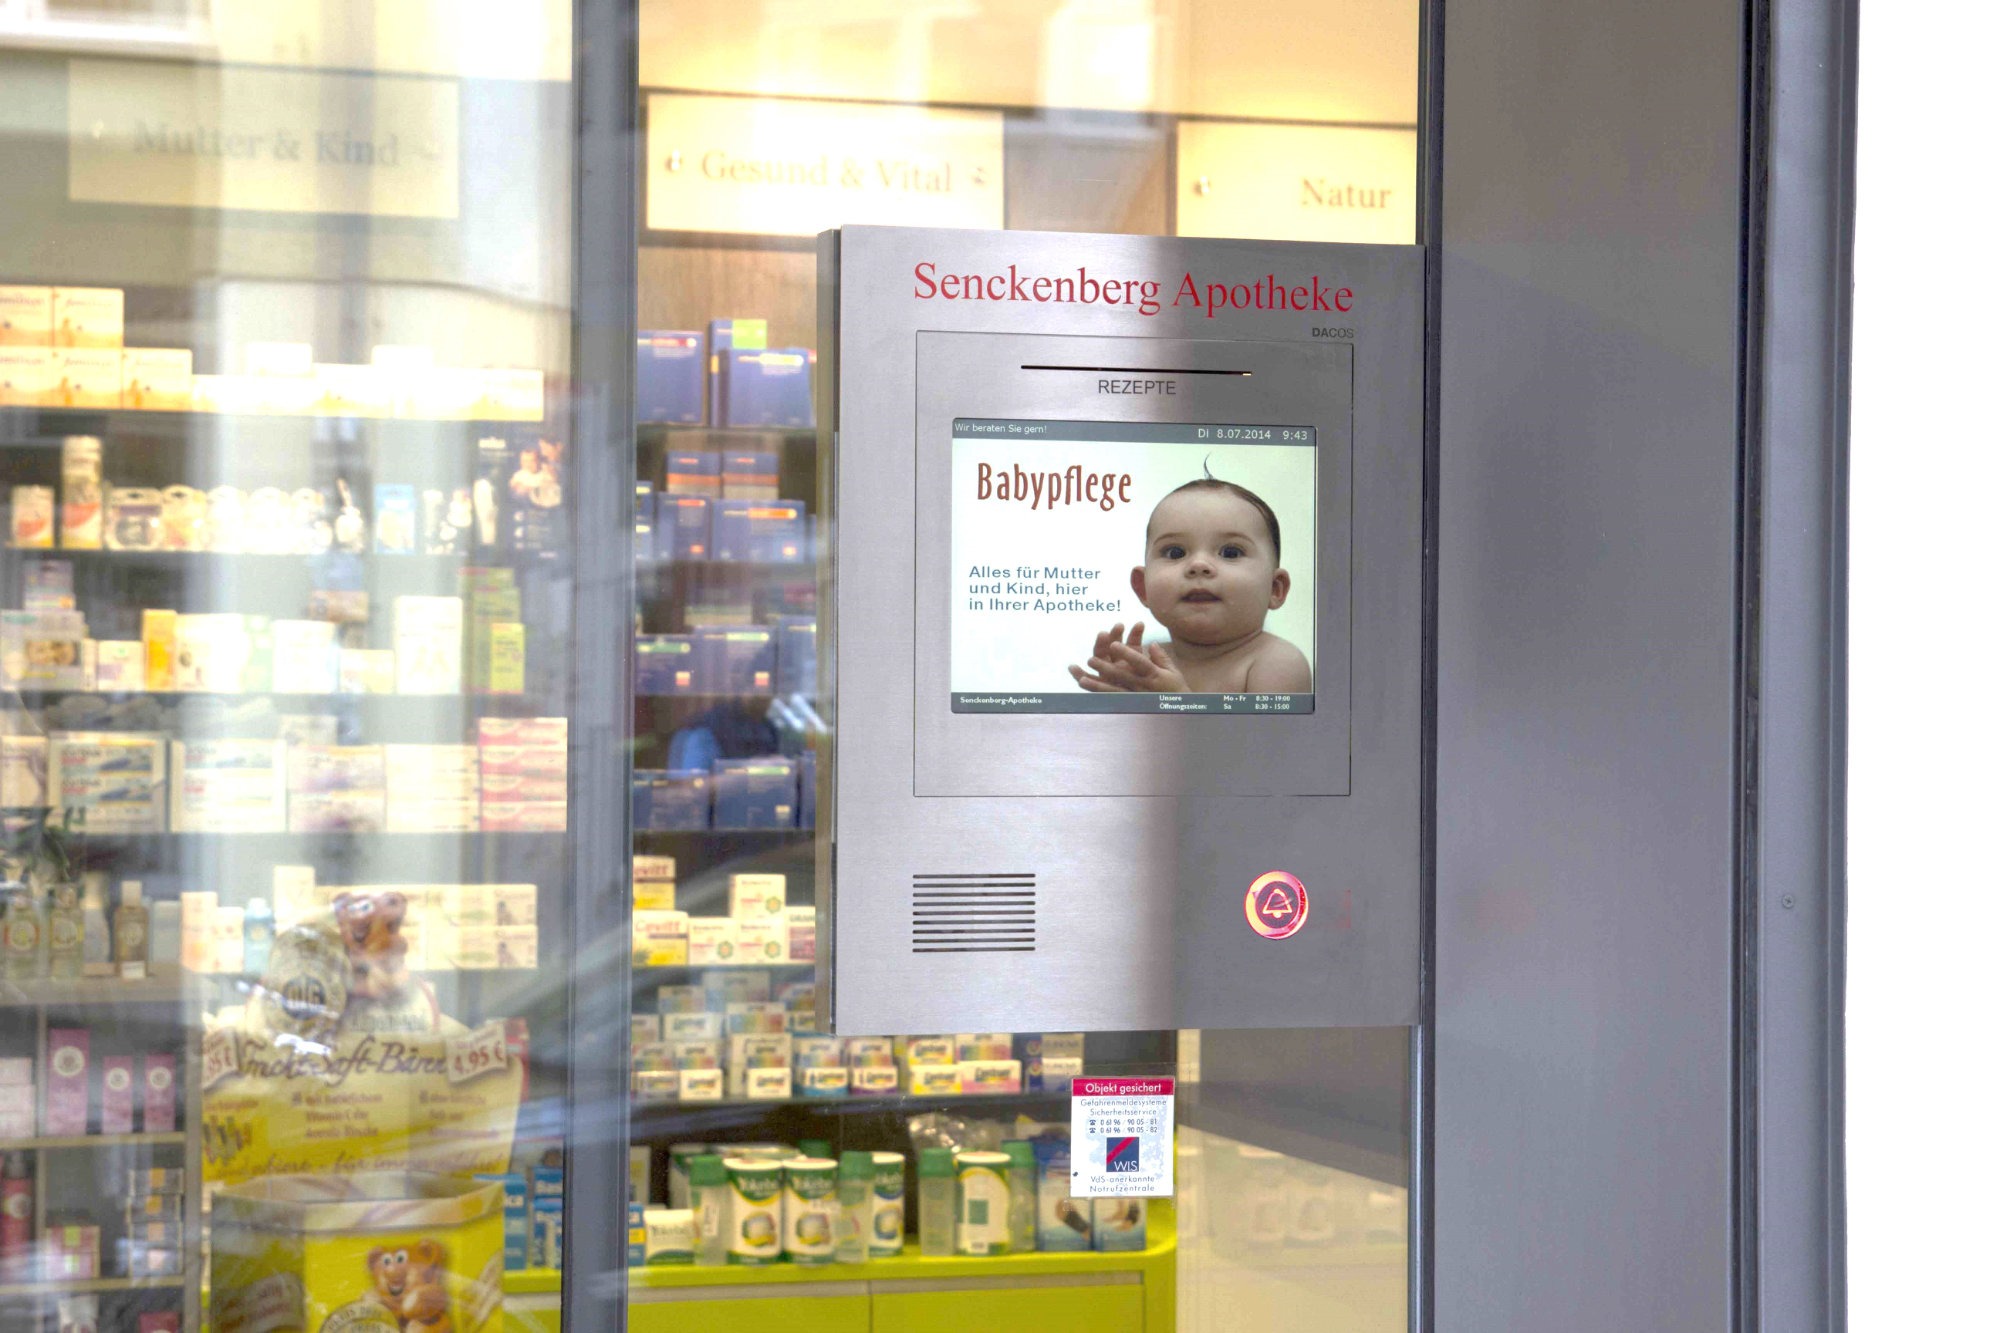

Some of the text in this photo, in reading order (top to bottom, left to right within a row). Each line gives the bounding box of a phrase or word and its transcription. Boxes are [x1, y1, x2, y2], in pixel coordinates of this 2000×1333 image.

[134, 121, 400, 166] Mutter & Kind
[701, 149, 952, 192] Gesund & Vital
[1301, 177, 1392, 209] Natur
[914, 262, 1354, 318] Senckenberg Apotheke
[1312, 327, 1354, 338] DACOS
[1098, 379, 1176, 396] REZEPTE
[954, 423, 1047, 435] Wir beraten Sie gern!
[1217, 429, 1271, 440] 8.07.2014
[1282, 430, 1308, 441] 9:43
[977, 462, 1132, 512] Babypflege
[969, 566, 1101, 580] Alles für Mutter
[969, 582, 1089, 597] und Kind, hier
[969, 598, 1121, 614] in Ihrer Apotheke!
[1085, 1082, 1162, 1095] Objekt gesichert
[1080, 1098, 1167, 1107] Gefahrenmeldesysteme
[1090, 1108, 1157, 1116] Sicherheitsservice
[1113, 1160, 1138, 1172] WIS
[1090, 1175, 1155, 1183] VdS-anerkannte
[1089, 1184, 1155, 1193] Notrufzentrale
